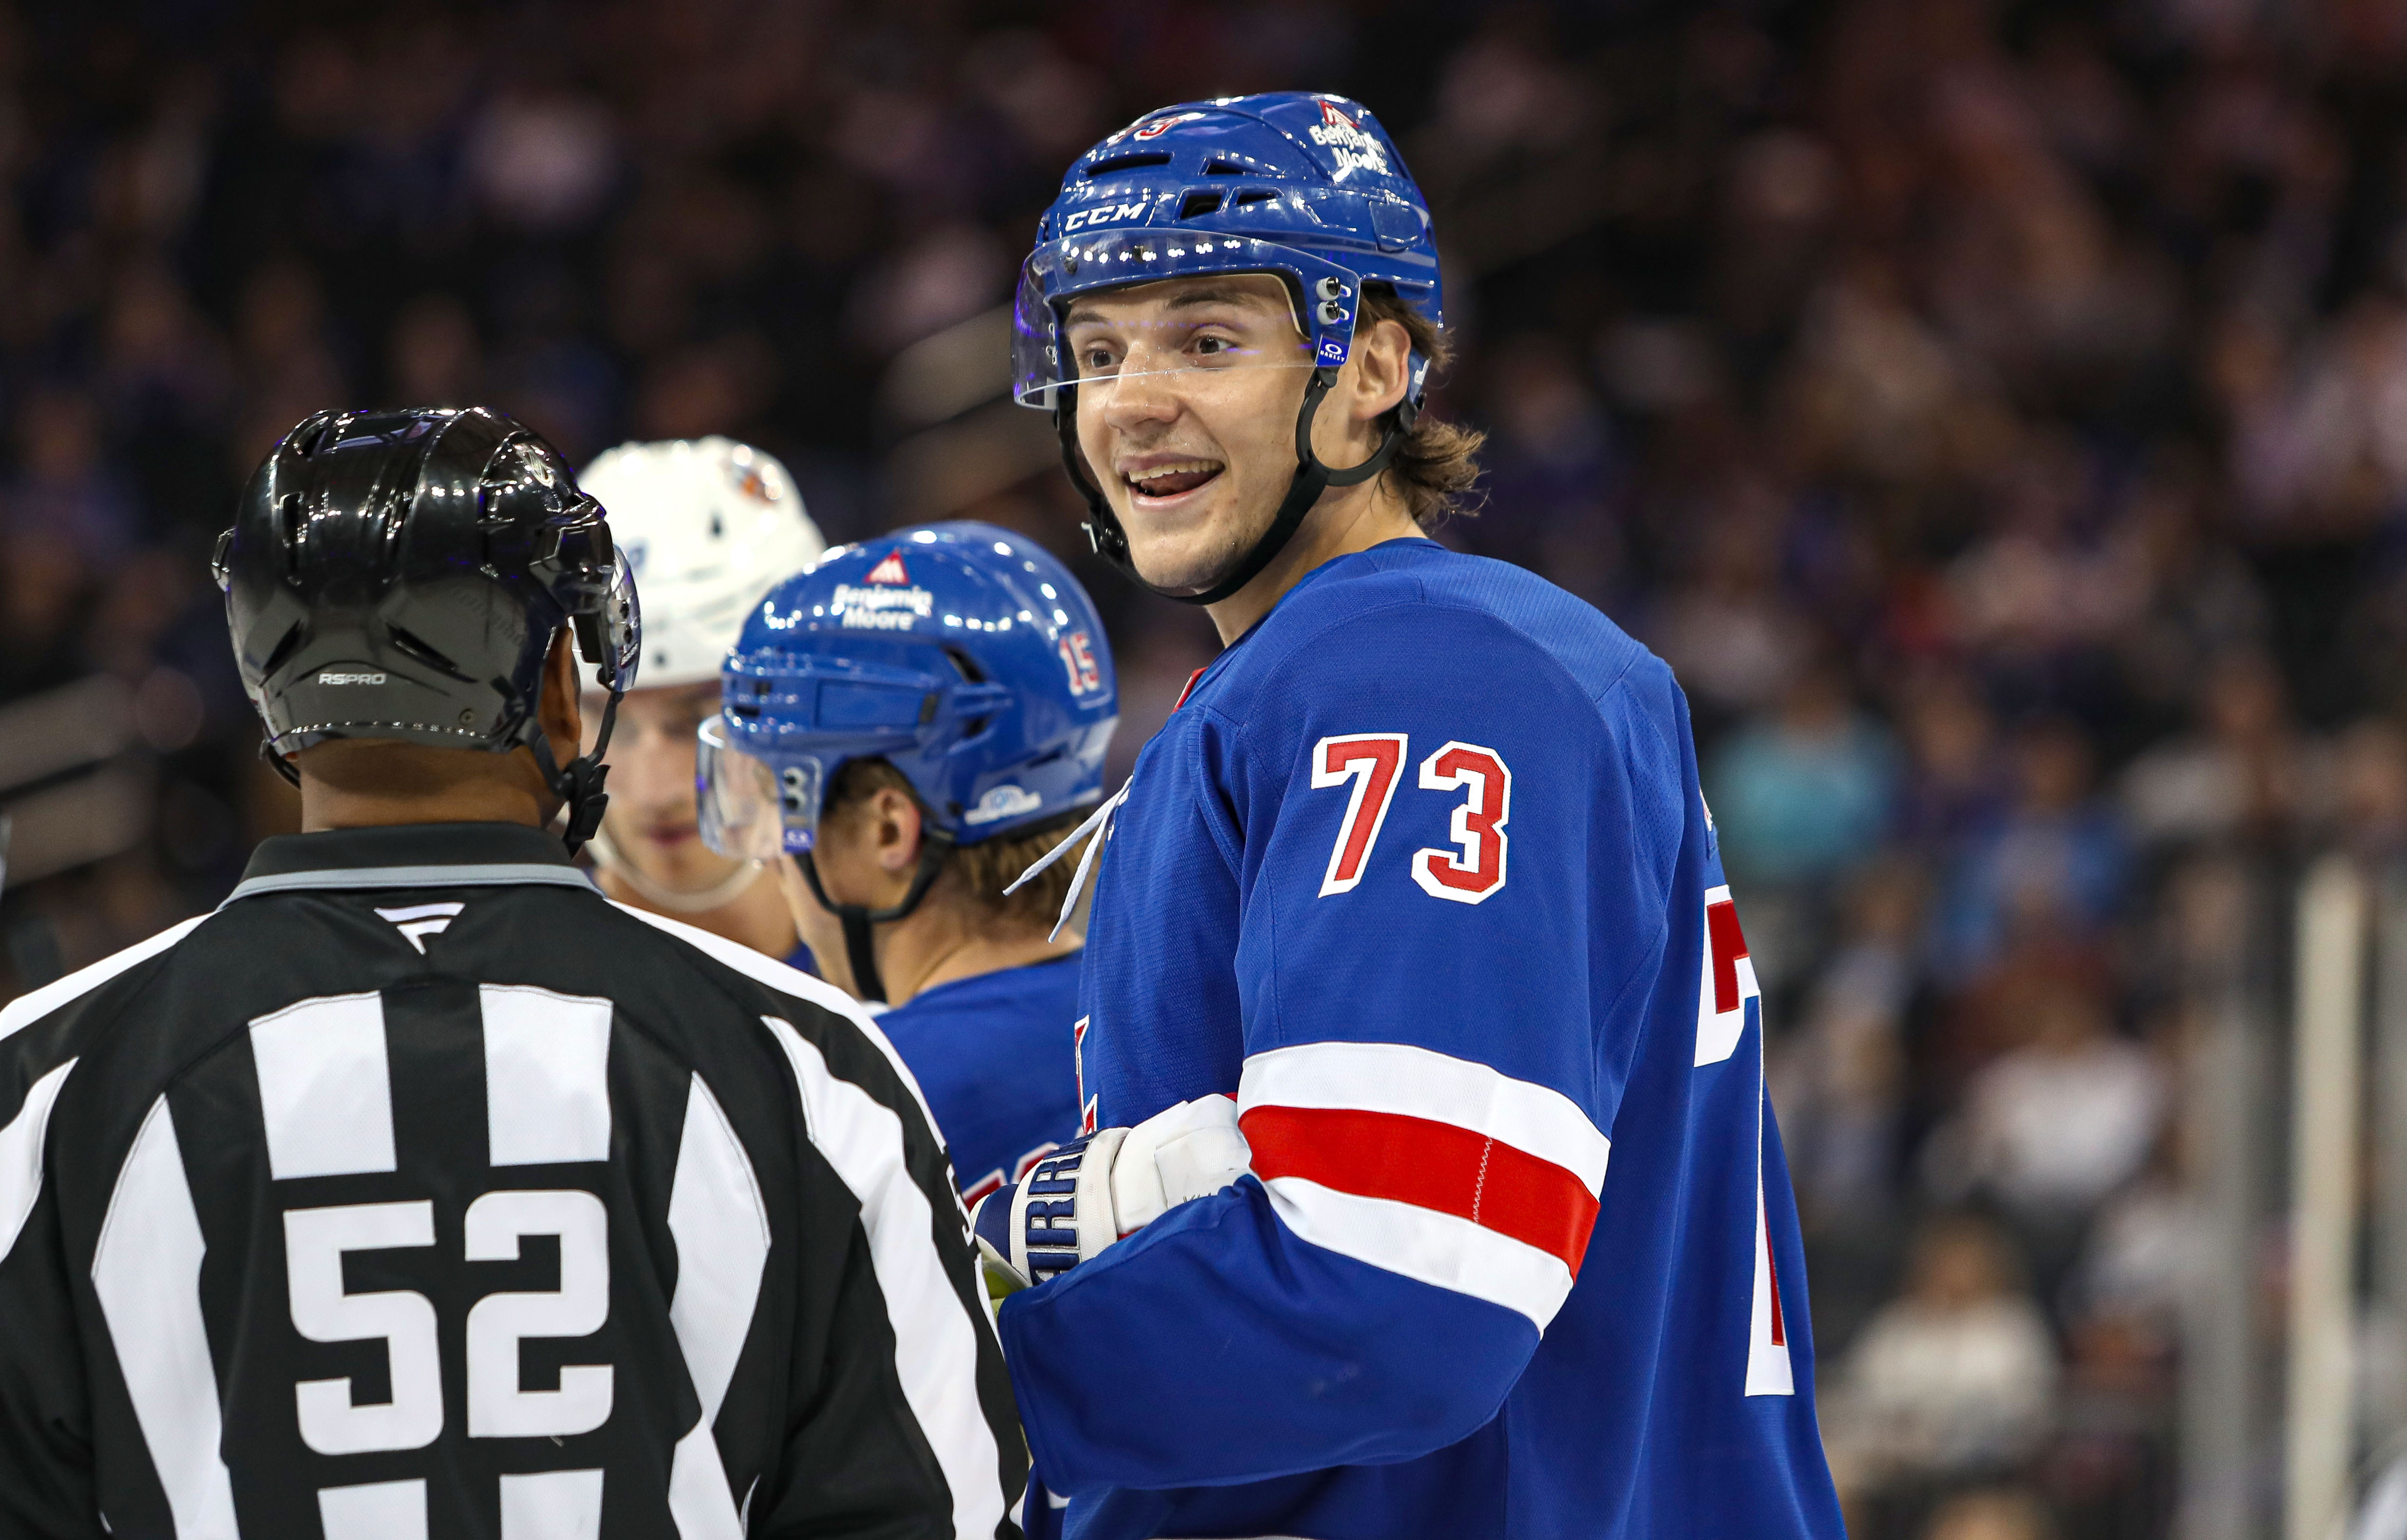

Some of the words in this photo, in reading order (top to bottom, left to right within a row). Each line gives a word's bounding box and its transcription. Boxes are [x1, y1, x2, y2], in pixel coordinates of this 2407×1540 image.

[1065, 202, 1146, 232] CCM
[842, 606, 914, 631] Moore
[1059, 632, 1100, 696] 15
[1311, 732, 1512, 905] 73
[283, 1189, 614, 1456] 52
